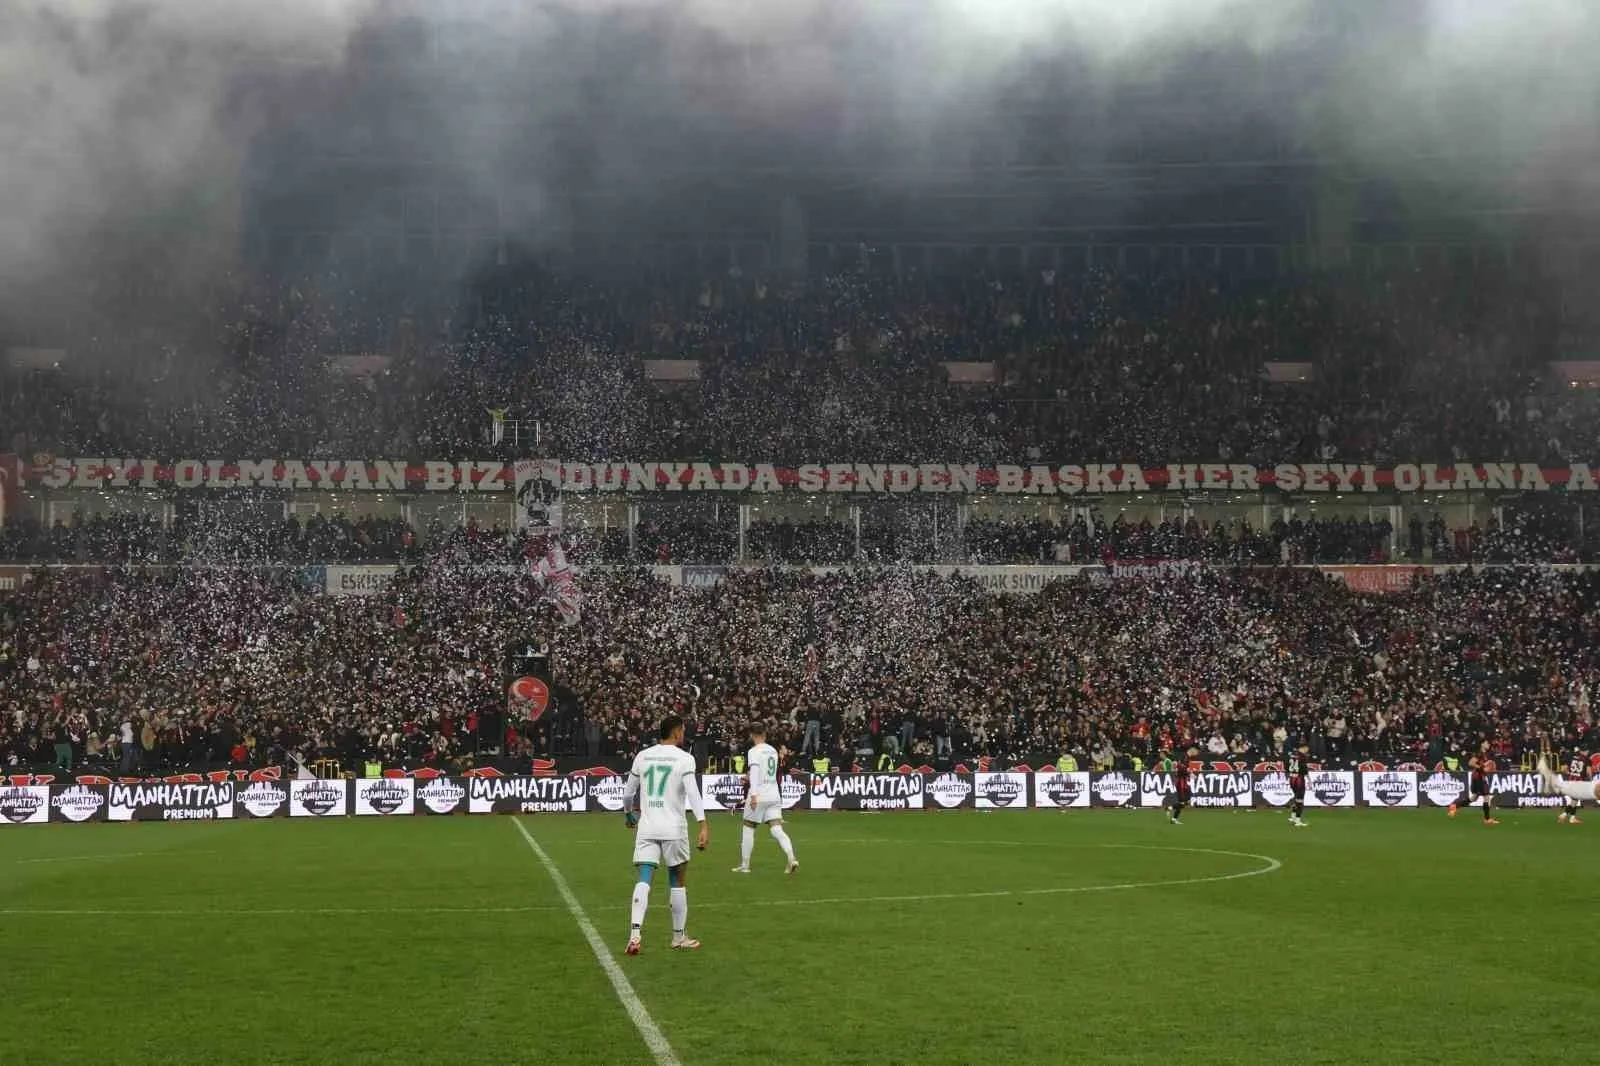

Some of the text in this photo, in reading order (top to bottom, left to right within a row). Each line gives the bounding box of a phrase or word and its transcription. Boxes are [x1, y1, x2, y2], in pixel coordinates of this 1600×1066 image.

[174, 459, 406, 490] OLMAYAN
[425, 461, 505, 490] BIZ
[798, 463, 978, 492] SENDEN
[1166, 464, 1259, 491] HER
[1393, 463, 1549, 491] OLANA
[767, 756, 776, 777] 9
[1569, 760, 1584, 773] 53
[647, 764, 677, 797] 17
[812, 774, 922, 797] MANHATTAN
[417, 788, 464, 799] MANHATTAN
[472, 778, 585, 801] MANHATTAN
[590, 786, 626, 796] MANHATT
[926, 784, 972, 794] MANHATTAN
[1092, 783, 1137, 793] MANHATTAN
[112, 784, 232, 808] MANHATTAN
[237, 792, 286, 803] MANHATTAN
[294, 791, 342, 802] MANHATTAN
[361, 790, 408, 801] MANHATTAN
[0, 798, 43, 808] ANHATTAN
[53, 796, 103, 807] MANHATTAN
[520, 801, 568, 813] PREMIUM
[859, 798, 906, 810] PREMIUM
[1190, 796, 1235, 807] PREMIUM
[1518, 796, 1563, 807] PREMIUM
[163, 808, 214, 821] PREMIUM
